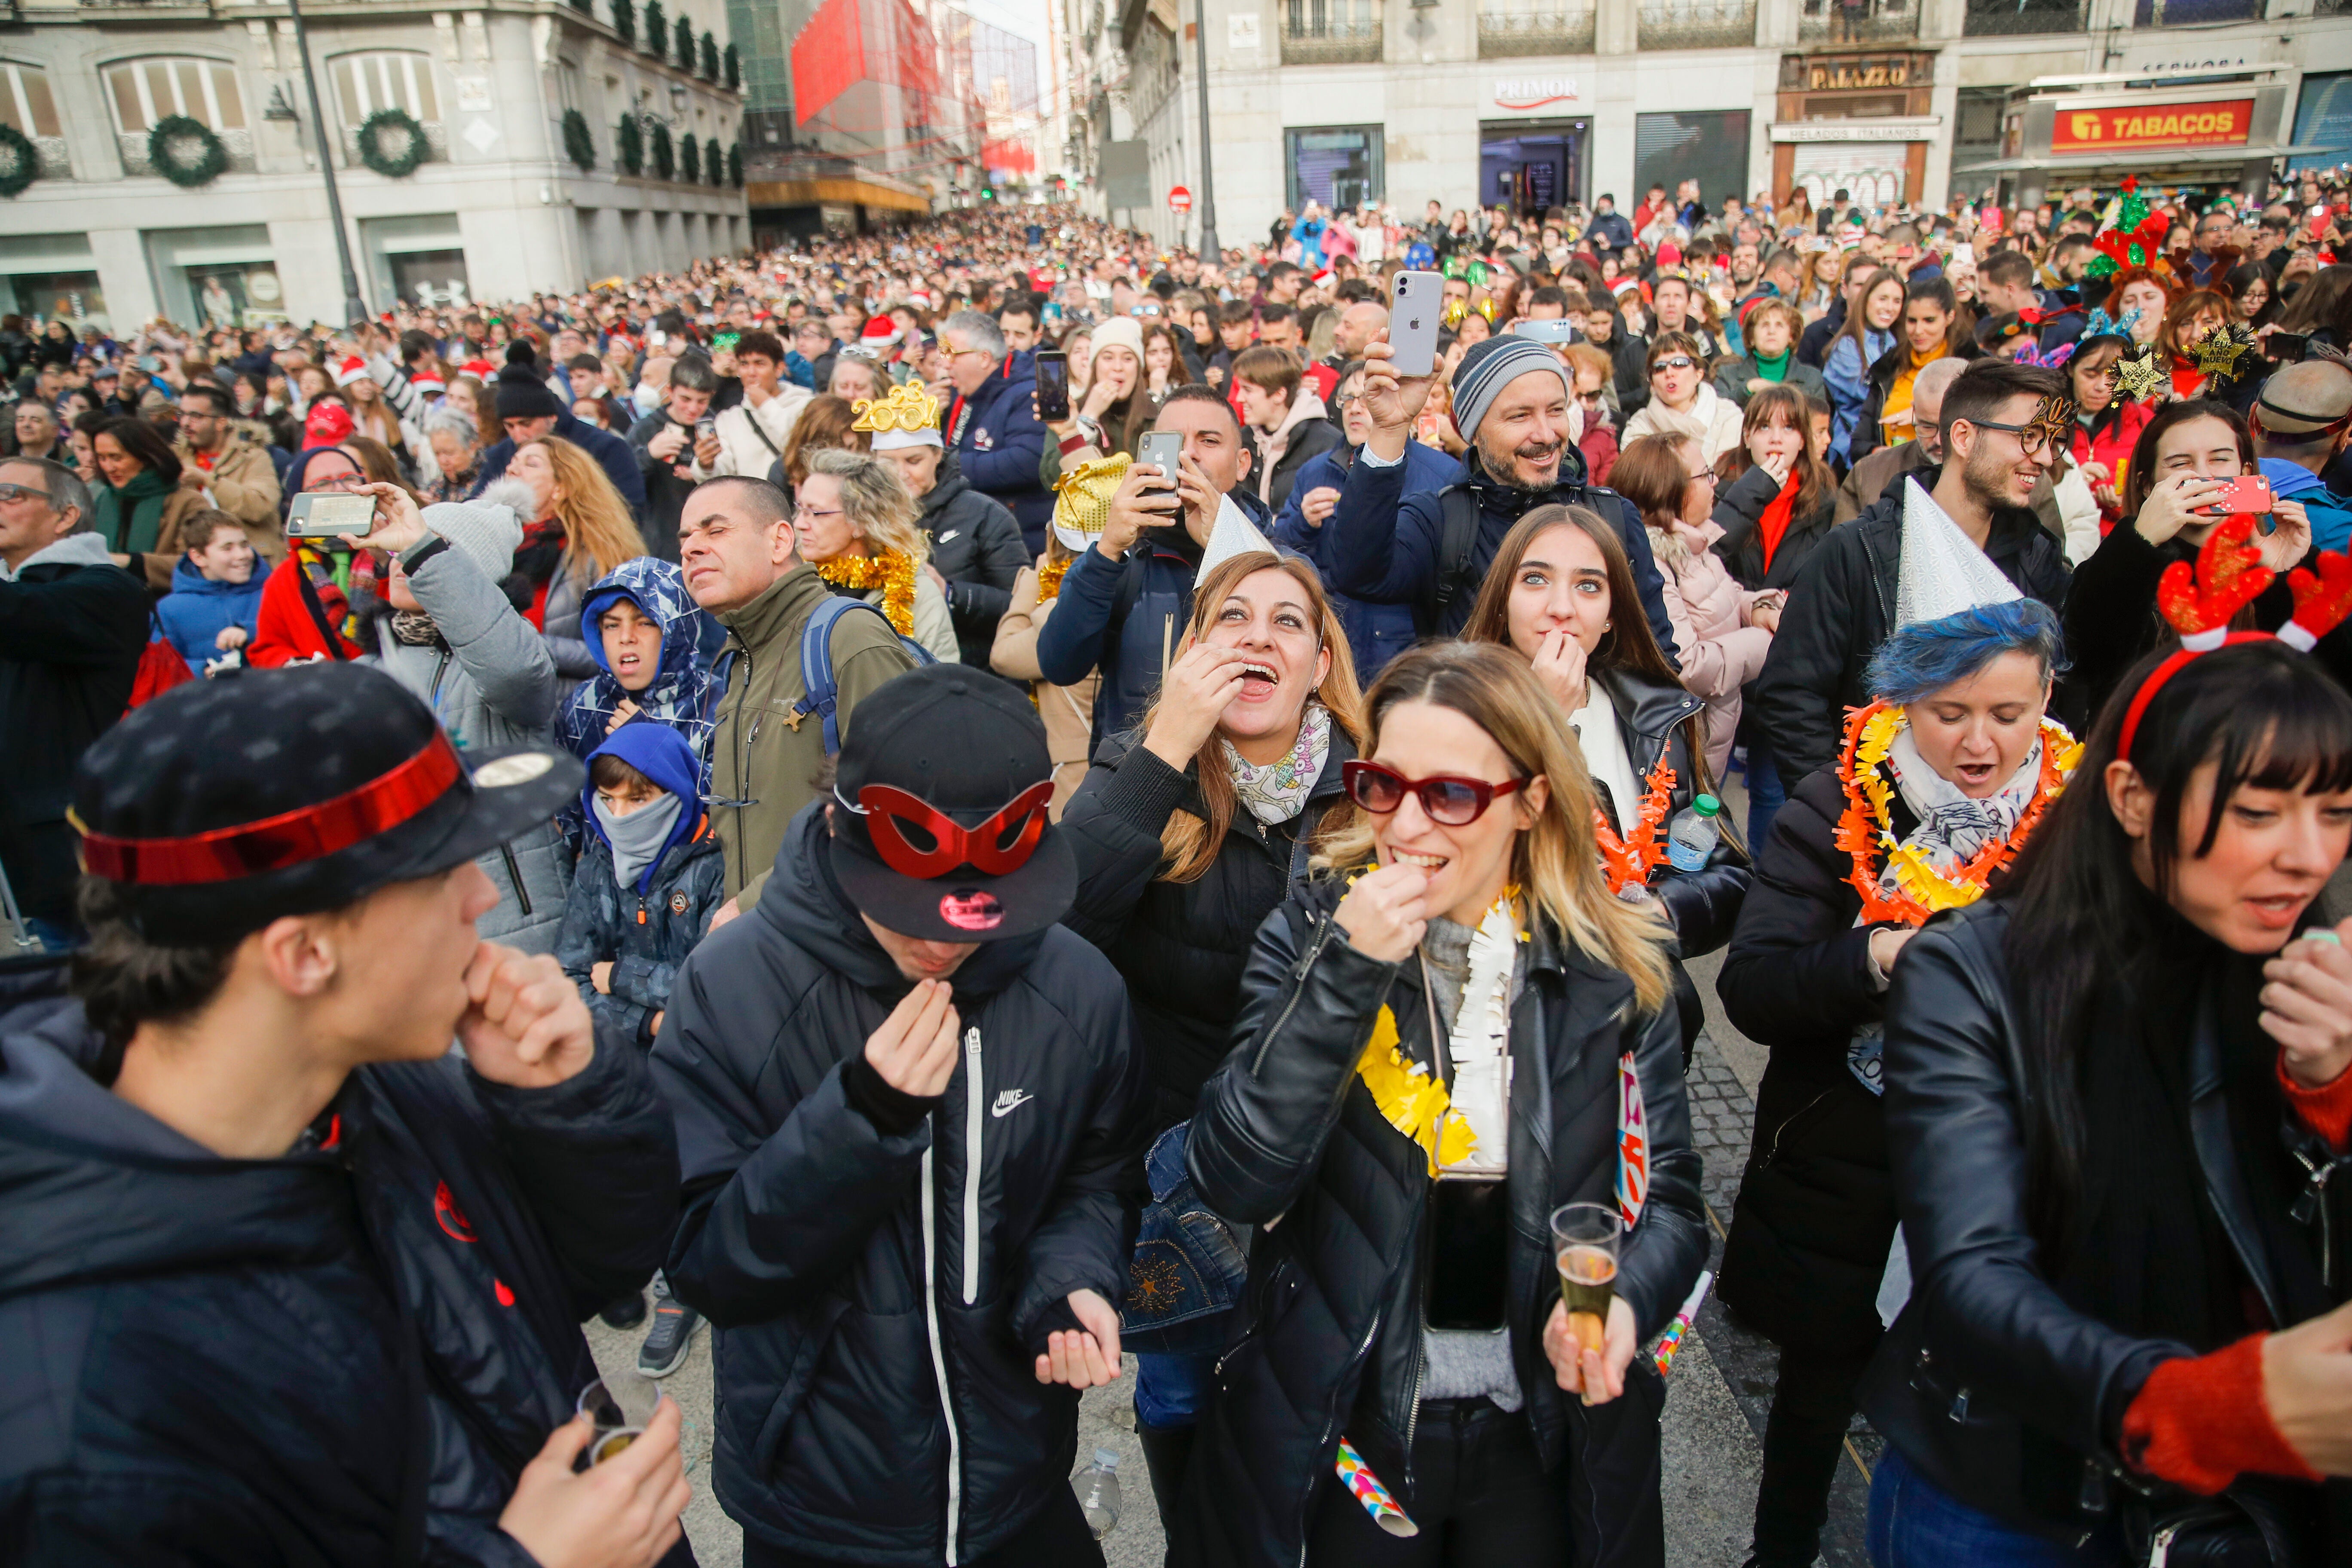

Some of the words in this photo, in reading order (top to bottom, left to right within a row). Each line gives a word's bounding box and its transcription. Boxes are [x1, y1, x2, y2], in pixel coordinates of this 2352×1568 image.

[1811, 66, 1907, 89] PALAZZO
[1494, 79, 1579, 99] PRIMOR
[1790, 129, 1849, 141] HELADOS
[1857, 128, 1921, 140] ITALIANOS
[2113, 112, 2233, 138] TABACOS
[2209, 341, 2233, 349] FELIZ
[2122, 362, 2143, 380] FELIZ
[2132, 370, 2155, 392] NUEVO
[2031, 396, 2082, 427] 2023
[997, 1088, 1023, 1106] NIKE
